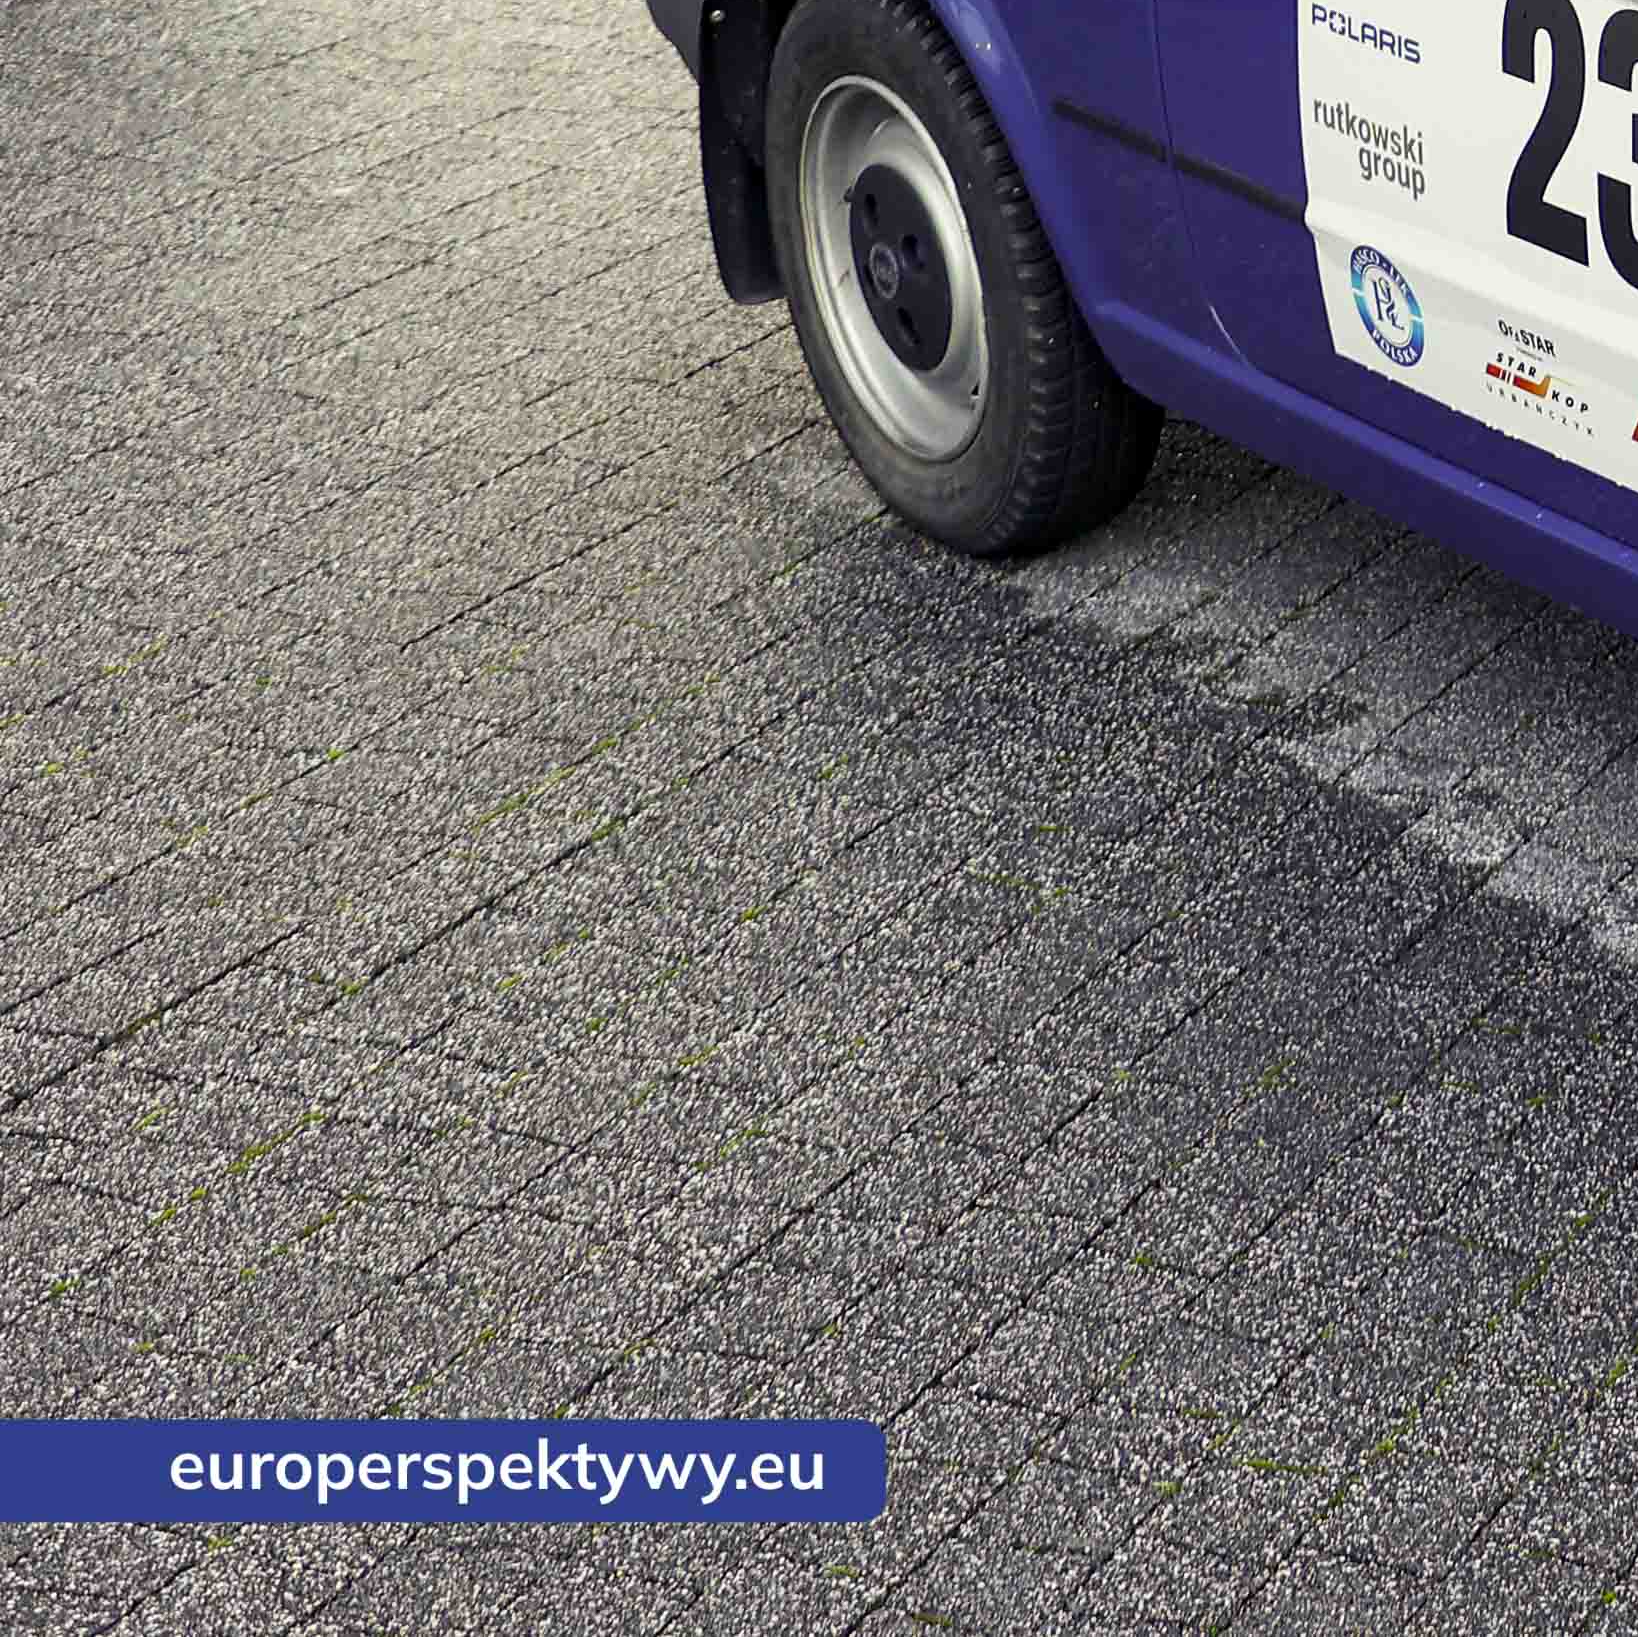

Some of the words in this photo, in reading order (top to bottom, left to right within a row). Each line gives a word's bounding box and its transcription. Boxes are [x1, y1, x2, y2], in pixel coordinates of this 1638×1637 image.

[1311, 3, 1421, 64] POLARIS
[1313, 97, 1425, 163] rutkowski
[1358, 144, 1425, 202] group
[1496, 352, 1537, 378] STAR
[1551, 389, 1589, 413] KOP
